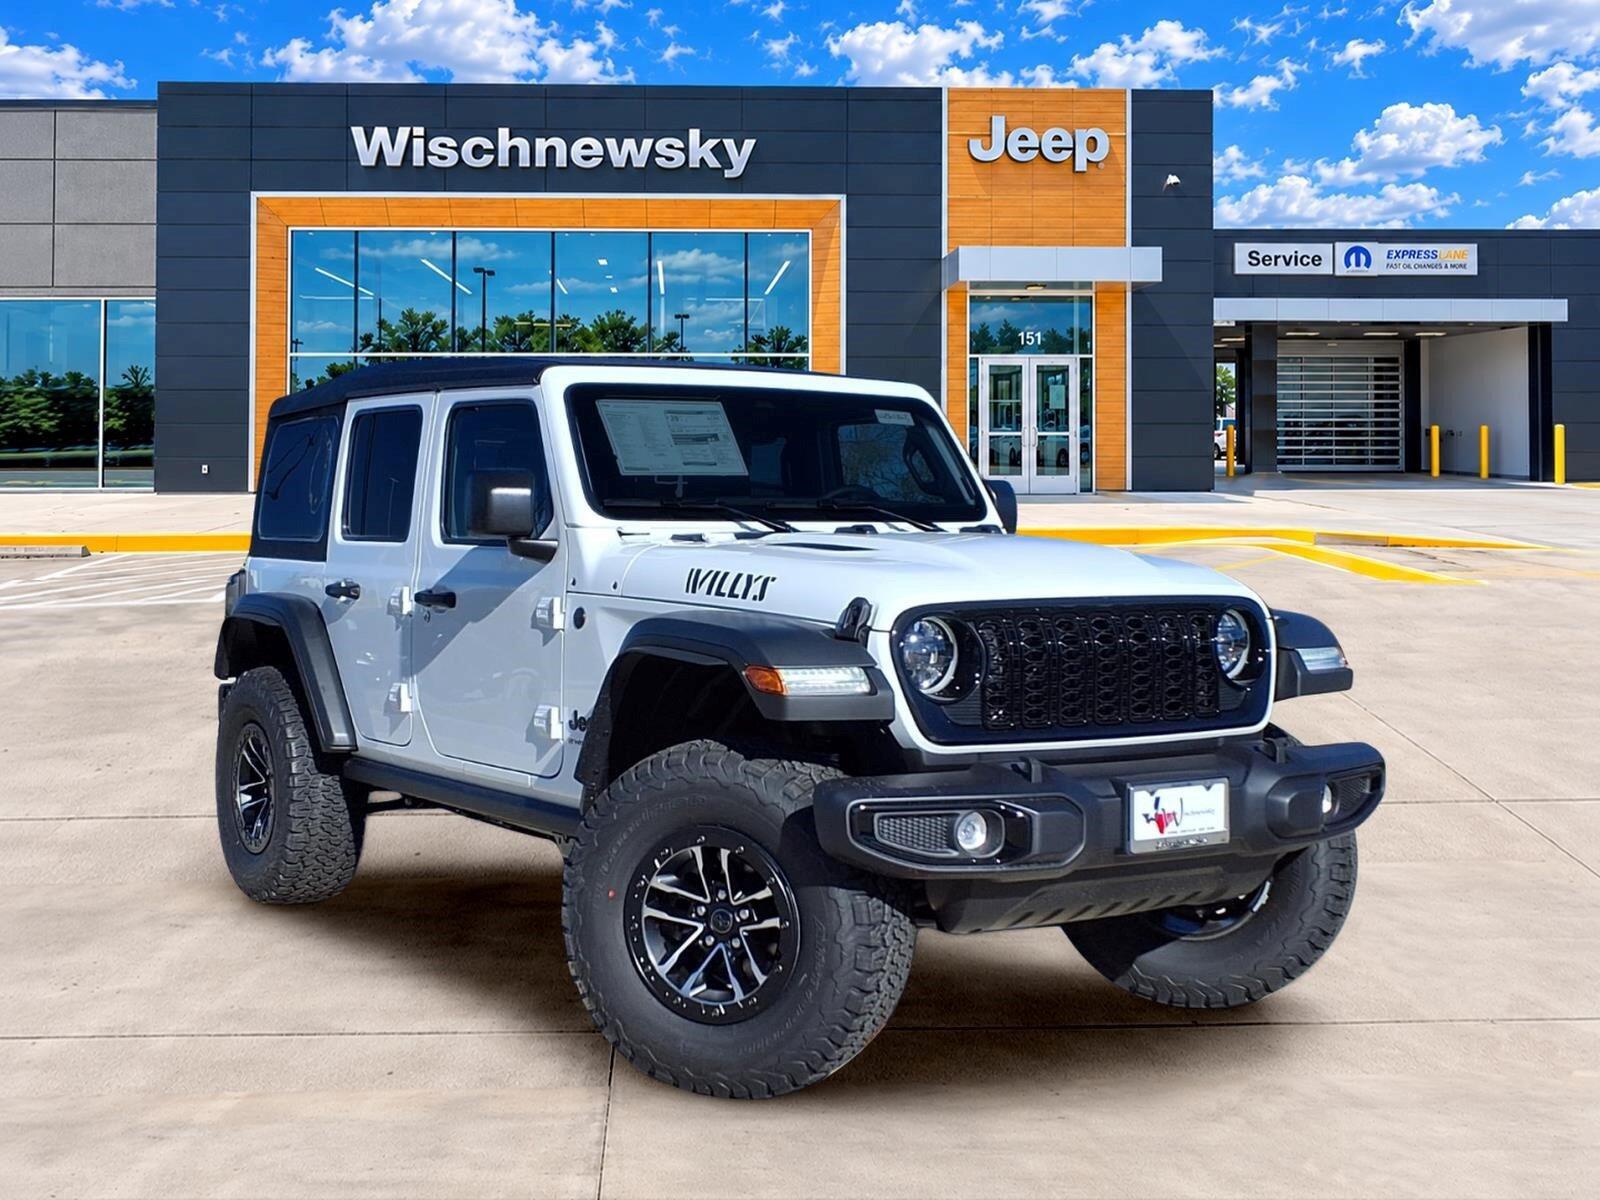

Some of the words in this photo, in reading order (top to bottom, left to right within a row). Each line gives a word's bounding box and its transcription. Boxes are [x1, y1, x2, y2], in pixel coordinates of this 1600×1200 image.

[350, 125, 757, 179] Wischnewsky
[968, 115, 1110, 172] Jeep
[1247, 250, 1323, 267] Service
[1386, 262, 1401, 270] FAST
[1017, 331, 1042, 346] 151
[684, 567, 778, 602] WILLYS
